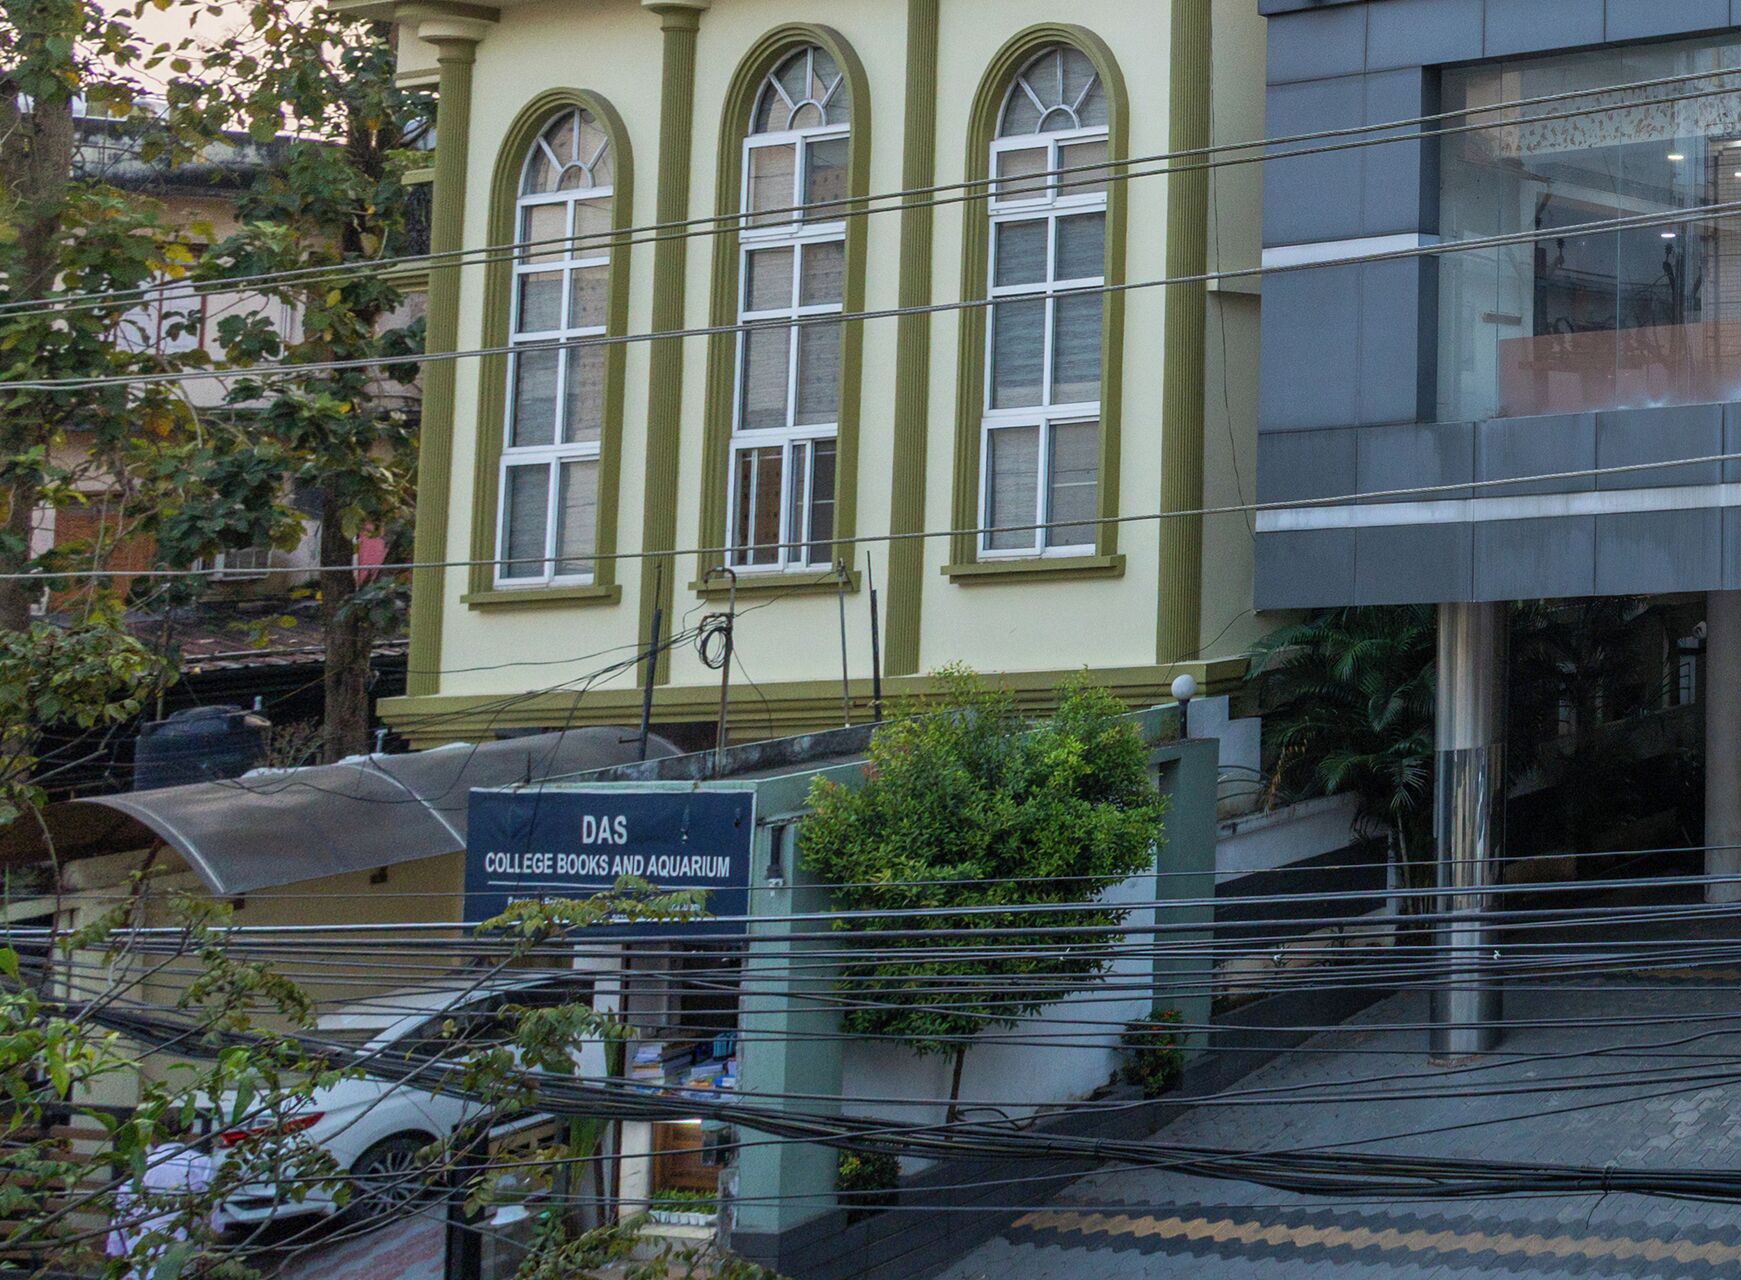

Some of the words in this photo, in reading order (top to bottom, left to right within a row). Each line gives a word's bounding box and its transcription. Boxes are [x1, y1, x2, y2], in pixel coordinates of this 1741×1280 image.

[582, 814, 628, 845] DAS
[485, 852, 553, 874] COLLEGE
[557, 854, 609, 876] BOOKS
[611, 855, 644, 877] AND
[647, 855, 730, 878] AQUARIUM
